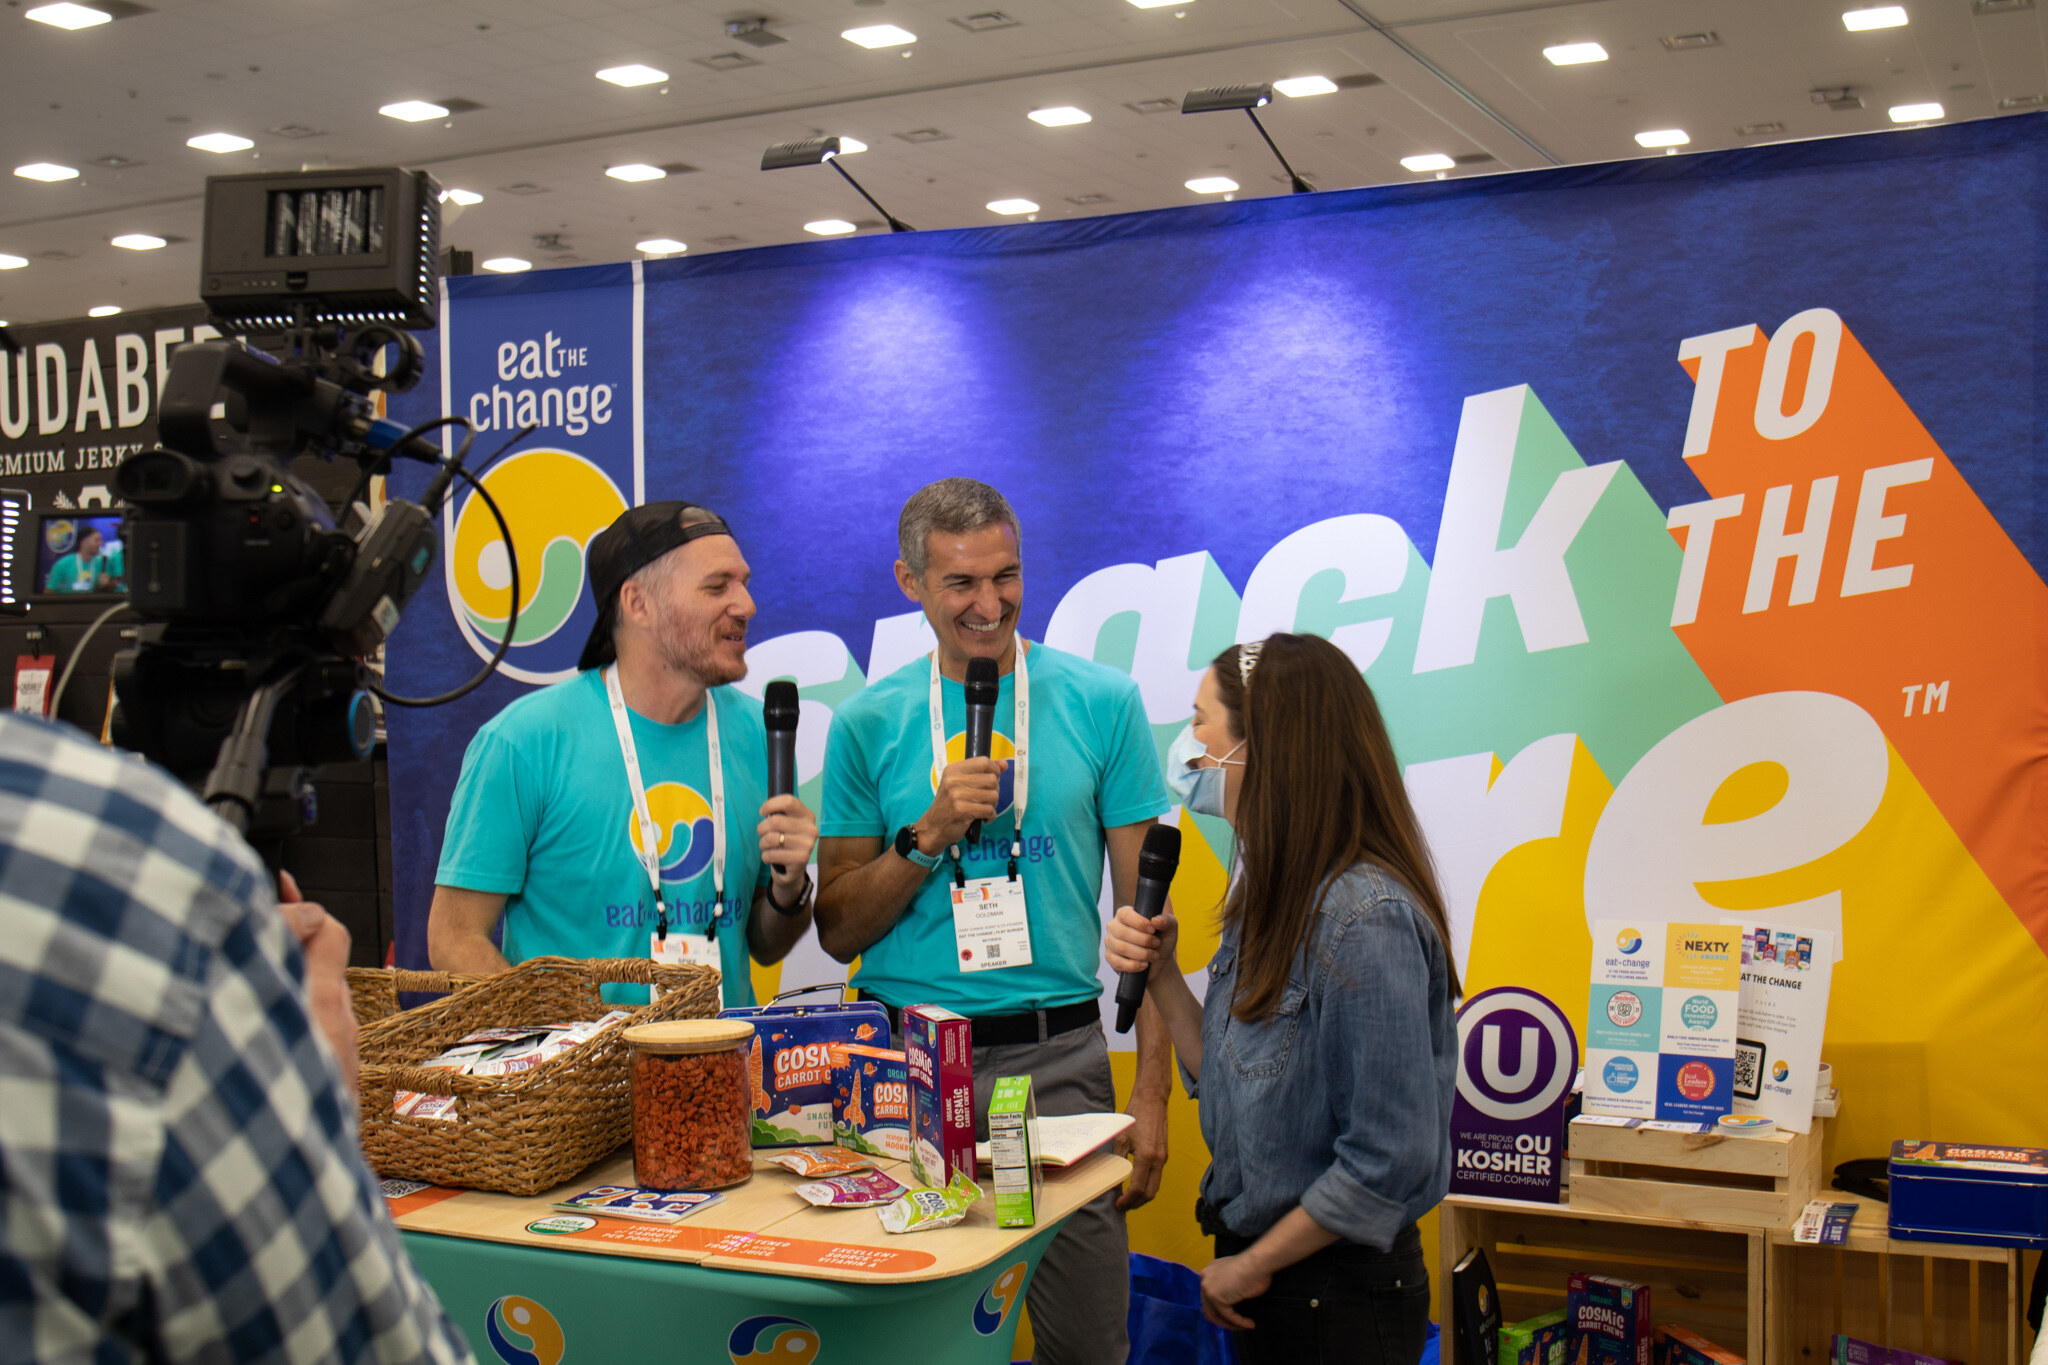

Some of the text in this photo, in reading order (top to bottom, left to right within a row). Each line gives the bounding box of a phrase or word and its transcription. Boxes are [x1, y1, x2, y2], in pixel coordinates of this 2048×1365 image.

[498, 330, 588, 381] eat THE
[1678, 307, 1842, 459] TO
[470, 383, 613, 436] change
[1667, 457, 1935, 627] THE
[979, 902, 998, 910] SETH
[976, 910, 1004, 919] GOLDMAN
[1685, 940, 1729, 952] NEXTY
[980, 960, 1007, 968] SPEAKER
[1605, 958, 1650, 969] eat change
[1740, 973, 1802, 990] AT THE CHANGE
[1685, 1004, 1715, 1014] FOOD
[778, 1069, 821, 1088] CARROT
[876, 1104, 903, 1116] CARROT
[945, 1098, 953, 1122] ORGANIC
[1460, 1131, 1513, 1143] WE ARE PROUD
[1480, 1140, 1513, 1150] TO BE AN
[1515, 1134, 1551, 1155] OU
[1457, 1149, 1551, 1175] KOSHER
[1456, 1170, 1551, 1188] CERTIFIED COMPANY
[720, 1239, 750, 1249] ONLY
[724, 1234, 791, 1248] SWEETENED
[704, 1242, 776, 1257] FRUIT JUICE
[831, 1247, 899, 1259] EXCELLENT
[817, 1256, 867, 1267] VITAMIN
[825, 1252, 872, 1262] SOURCE
[1578, 1320, 1625, 1339] CARROT CHEWS
